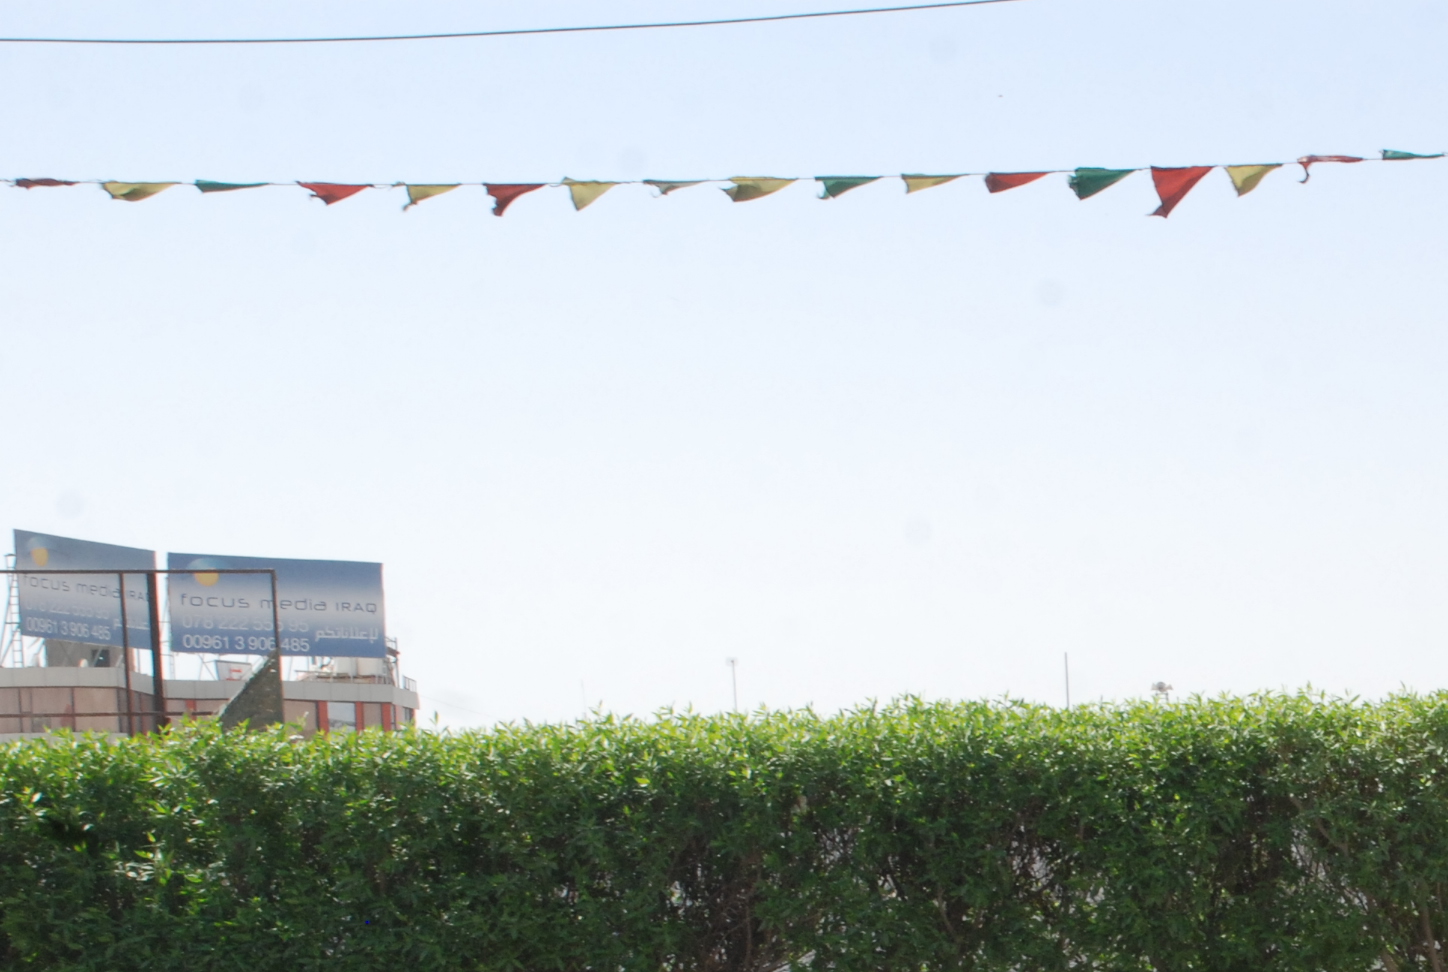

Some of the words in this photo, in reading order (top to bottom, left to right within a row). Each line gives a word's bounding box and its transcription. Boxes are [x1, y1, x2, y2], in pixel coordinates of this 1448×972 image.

[23, 575, 70, 592] focus
[75, 582, 120, 599] media
[126, 588, 149, 602] IRA
[180, 592, 250, 609] focus
[260, 597, 327, 612] media
[336, 601, 377, 615] IRAQ
[26, 616, 58, 634] 00961
[61, 620, 69, 636] 3
[70, 621, 90, 638] 906
[91, 625, 112, 641] 485
[182, 614, 214, 629] 078
[218, 615, 249, 631] 222
[288, 618, 310, 633] 95
[183, 634, 230, 650] 00961
[234, 635, 245, 651] 3
[248, 636, 277, 652] 906
[280, 638, 311, 653] 485
